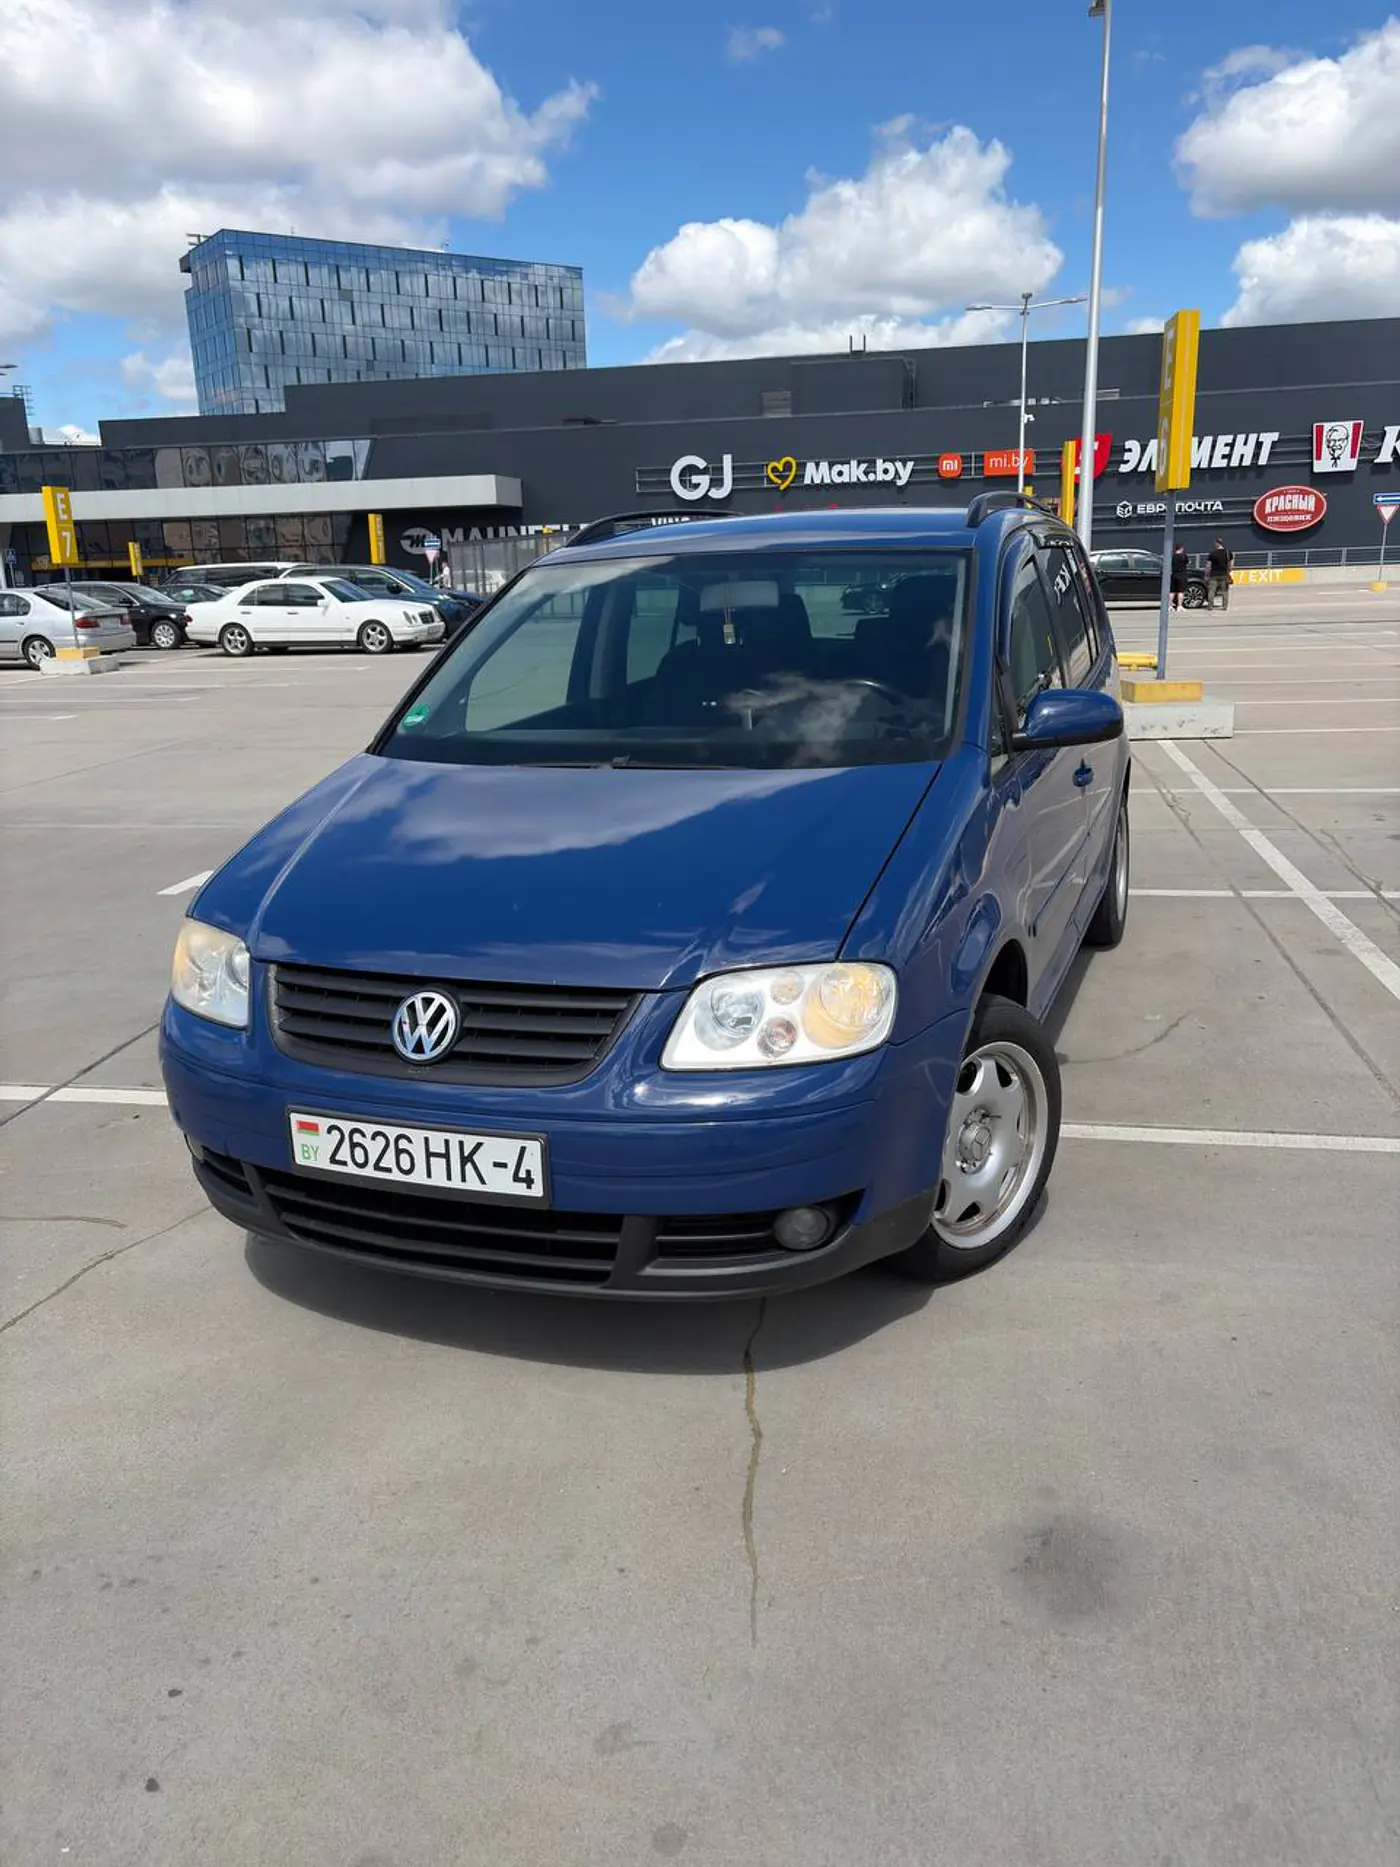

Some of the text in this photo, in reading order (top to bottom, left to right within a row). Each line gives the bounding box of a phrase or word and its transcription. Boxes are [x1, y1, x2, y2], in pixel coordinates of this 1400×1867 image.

[1118, 432, 1280, 473] ЭЛМЕНТ
[670, 454, 733, 500] GJ
[804, 459, 915, 486] Mak.by
[56, 493, 68, 520] E
[1137, 501, 1223, 514] ЕВРПОЧТА
[61, 530, 71, 559] 7
[1249, 569, 1284, 584] EXIT
[300, 1144, 319, 1161] BY
